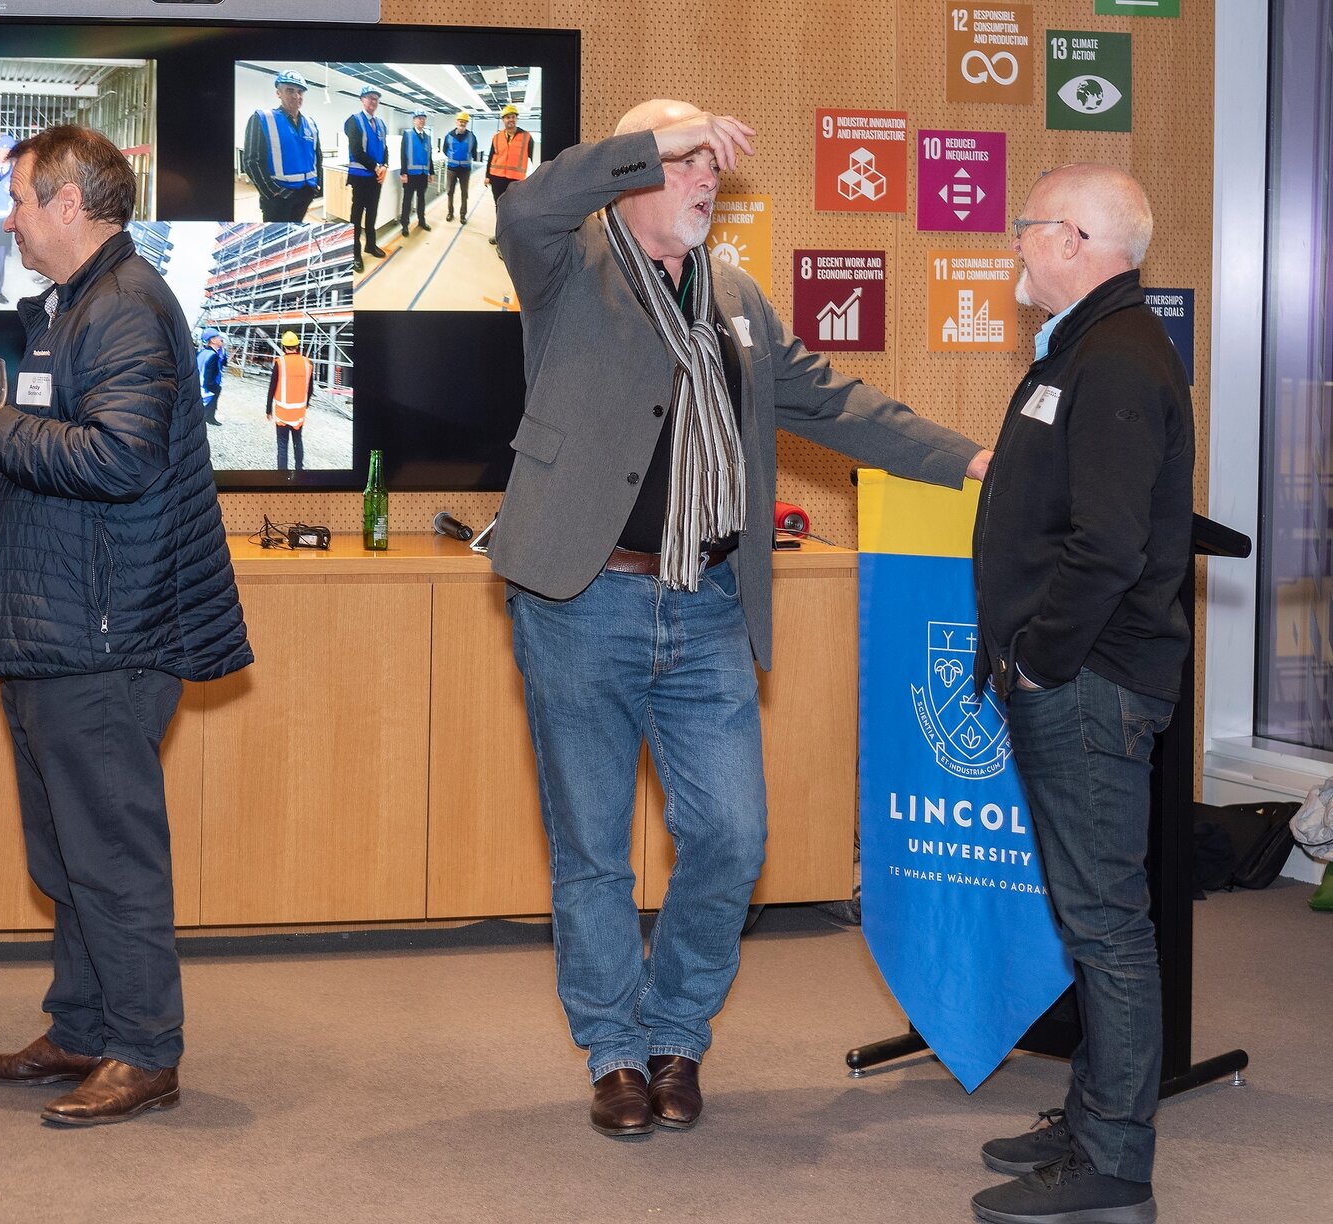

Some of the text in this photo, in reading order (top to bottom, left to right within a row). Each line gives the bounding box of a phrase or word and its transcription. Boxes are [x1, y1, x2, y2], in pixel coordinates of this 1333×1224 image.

[951, 9, 1015, 32] 12 RESPONSIBLE
[973, 22, 1018, 34] CONSUMPTION
[973, 34, 1028, 46] AND PRODUCTION
[1051, 37, 1099, 60] 13 CLIMATE
[1072, 50, 1095, 61] ACTION
[822, 115, 906, 139] 9 INDUSTRY, INNOVATION
[837, 129, 906, 141] AND INFRASTRUCTURE
[923, 137, 976, 160] 10 REDUCED
[945, 149, 989, 161] INEQUALITIES
[749, 201, 764, 212] AND
[712, 213, 755, 224] EAN ENERGY
[801, 257, 881, 280] 8 DECENT WORK AND
[818, 269, 883, 280] ECONOMIC GROWTH
[933, 258, 1014, 280] 11 SUSTAINABLE CITIES
[951, 271, 1010, 280] AND COMMUNITIES
[1144, 295, 1184, 305] RTNERSHIPS
[1163, 306, 1184, 317] GOALS
[917, 701, 934, 740] SCIENTIA
[890, 792, 1026, 834] LINCOL
[908, 838, 1031, 866] UNIVERSITY
[889, 866, 1048, 895] TE WHARE WĀNAKA O AORAK
